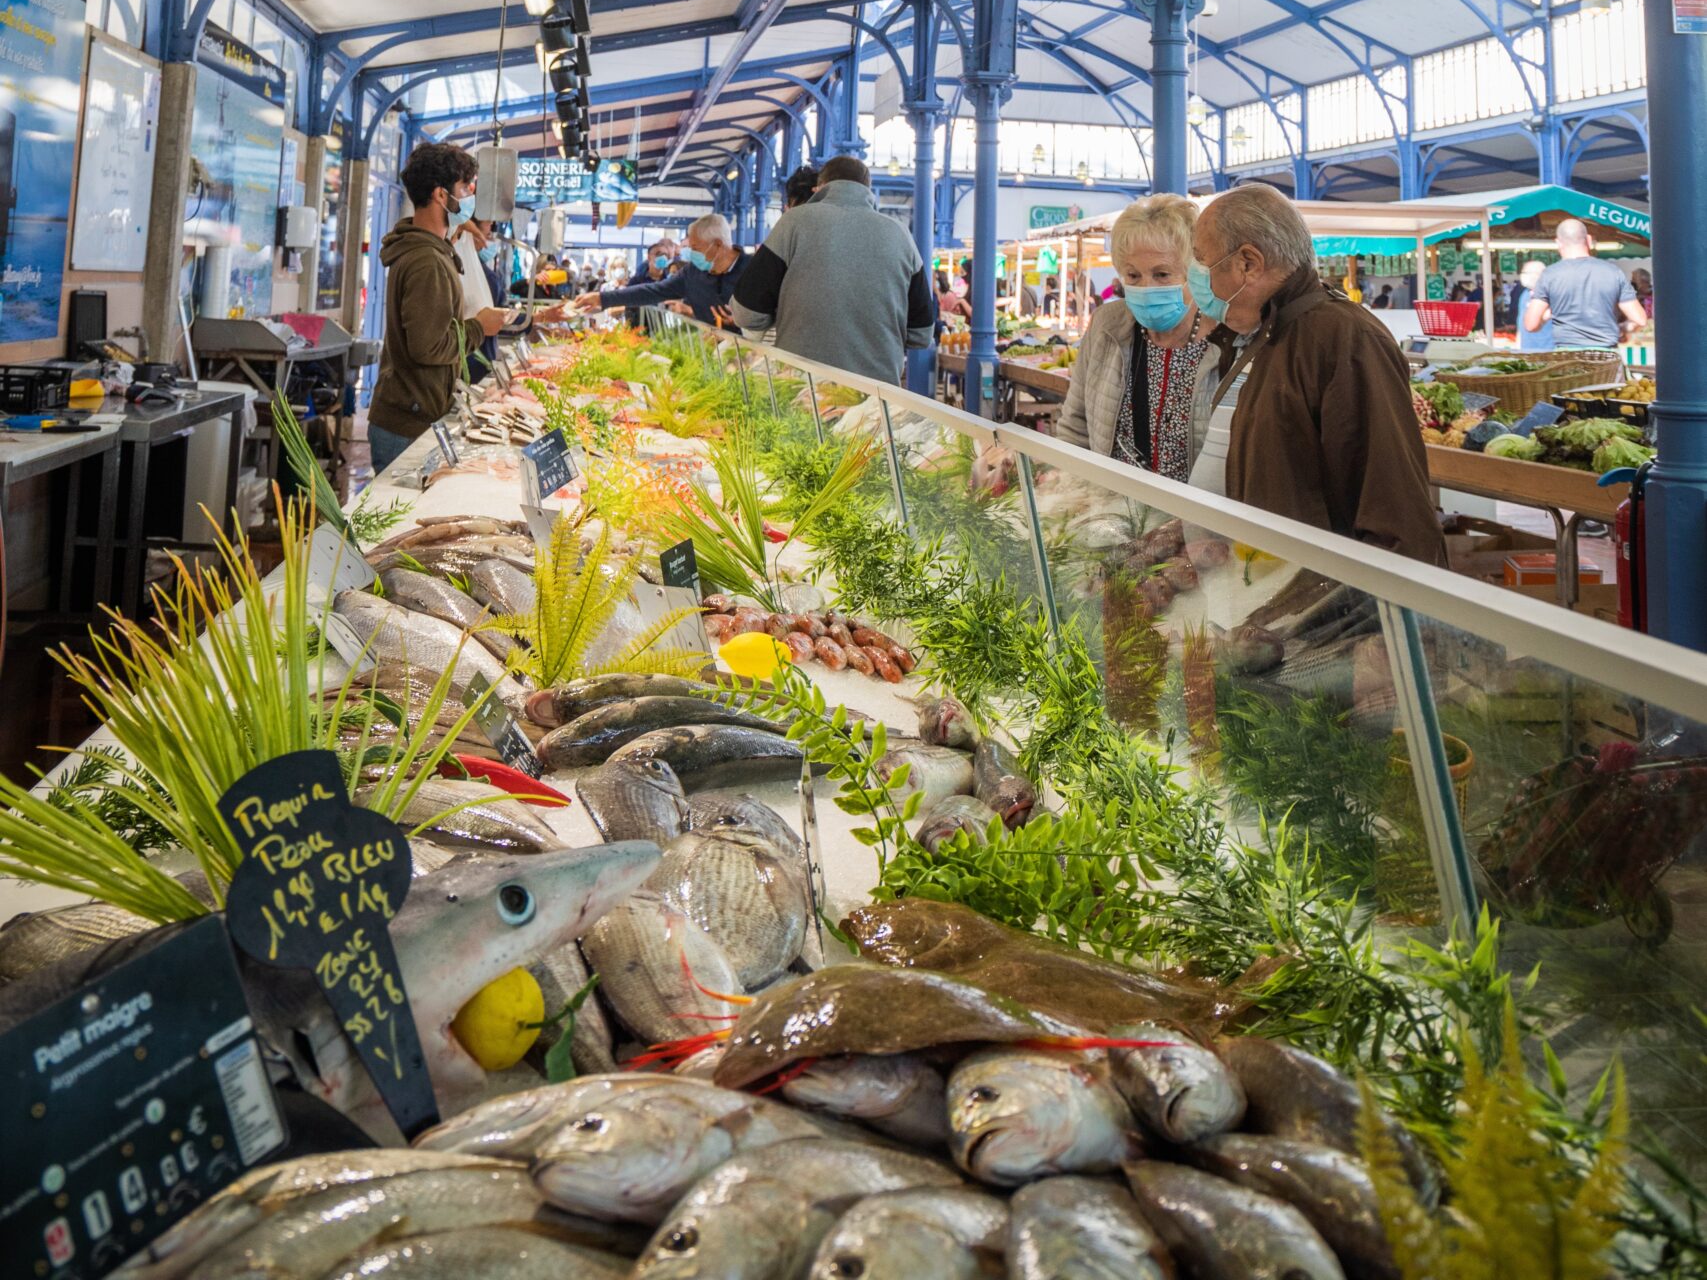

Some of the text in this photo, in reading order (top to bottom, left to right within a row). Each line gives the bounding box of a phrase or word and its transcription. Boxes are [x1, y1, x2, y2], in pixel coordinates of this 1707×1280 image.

[233, 783, 335, 837] Requin
[252, 832, 333, 874] Peau
[322, 839, 394, 883] BLEU
[34, 1028, 82, 1073] Petit
[83, 991, 153, 1044] maigre
